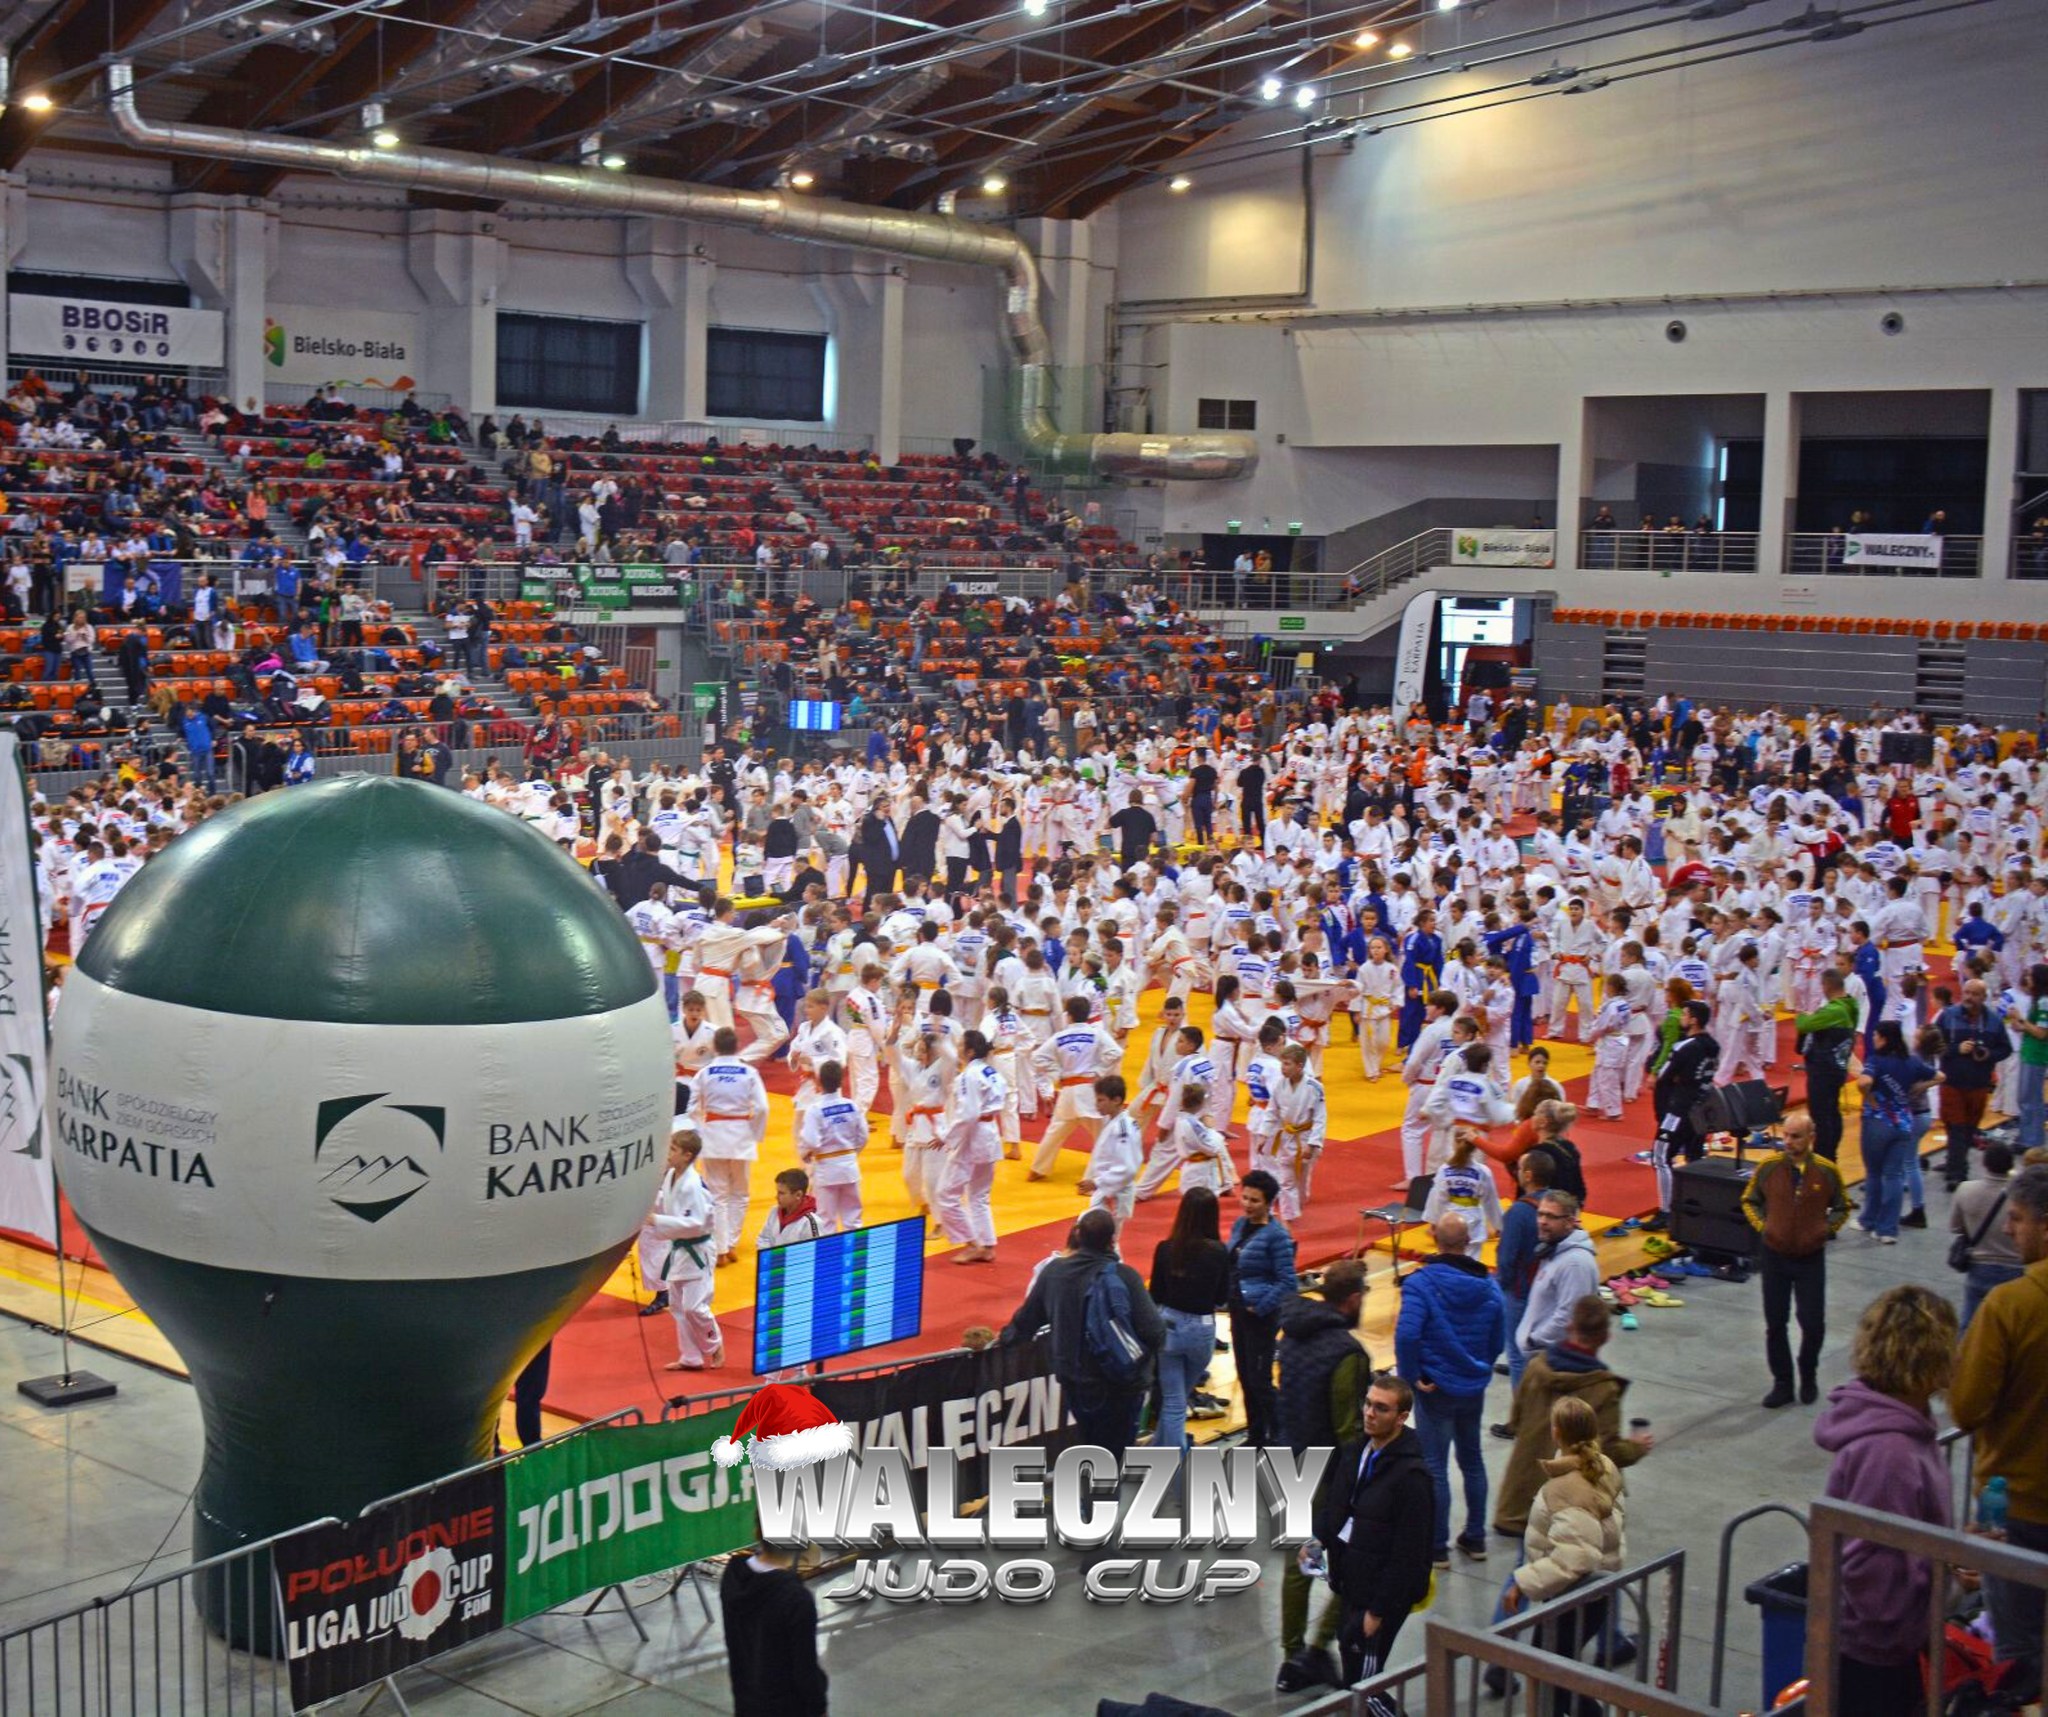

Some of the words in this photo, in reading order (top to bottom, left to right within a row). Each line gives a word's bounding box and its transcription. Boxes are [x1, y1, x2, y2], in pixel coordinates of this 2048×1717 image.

[62, 305, 169, 335] BBOSiR
[294, 336, 405, 360] Bielsko-Biała
[58, 1067, 110, 1121] BANK
[57, 1107, 215, 1188] KARPATIA
[489, 1114, 590, 1156] BANK
[486, 1134, 654, 1200] KARPATIA
[289, 1604, 361, 1660] LIGA
[443, 1553, 493, 1600] CUP
